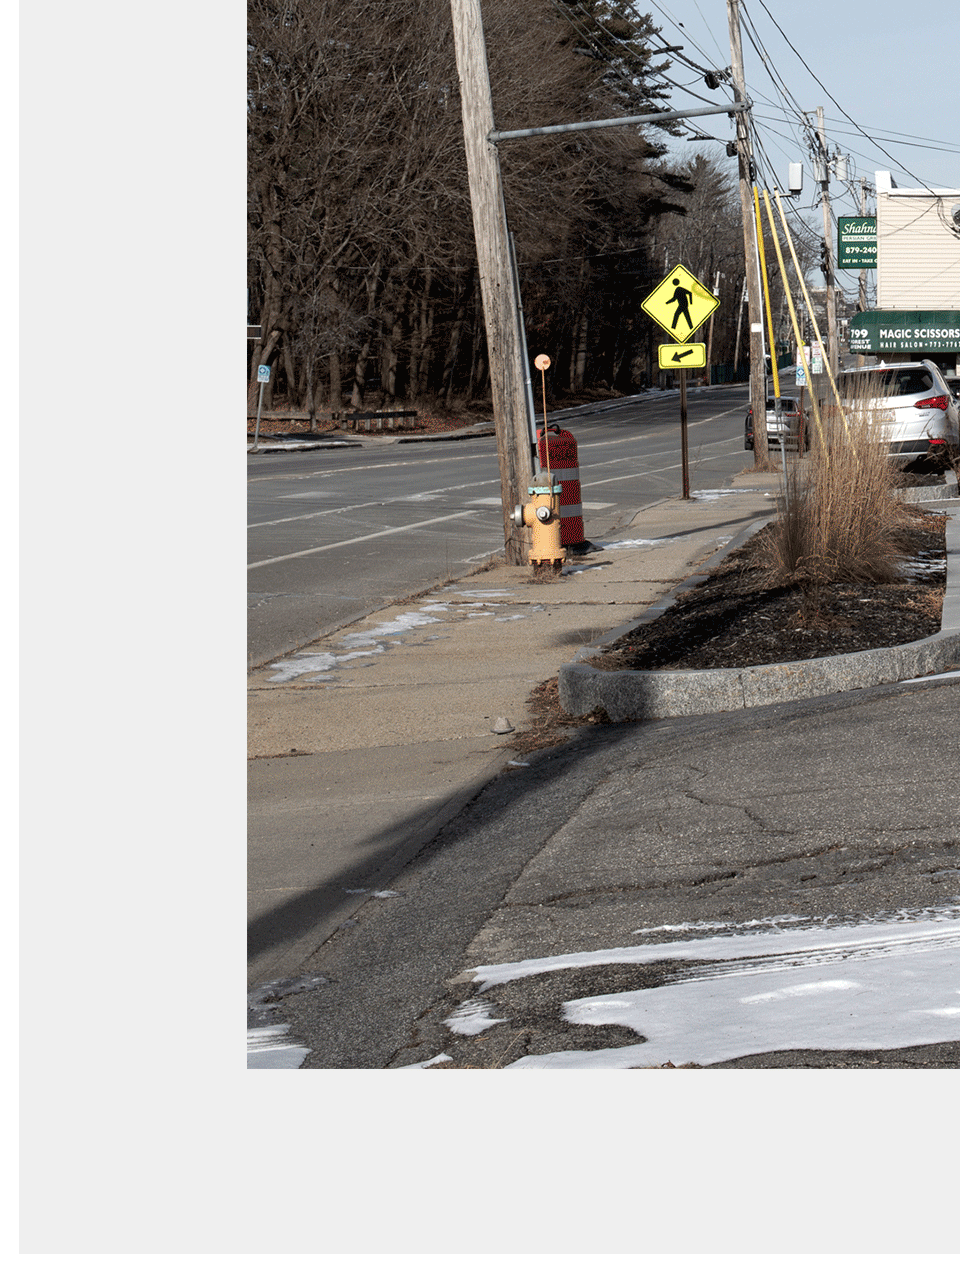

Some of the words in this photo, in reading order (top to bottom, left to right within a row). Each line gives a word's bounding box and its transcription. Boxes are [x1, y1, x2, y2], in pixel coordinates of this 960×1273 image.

[850, 328, 869, 339] 799
[879, 329, 912, 339] MAGIC
[914, 328, 960, 338] SCISSORS
